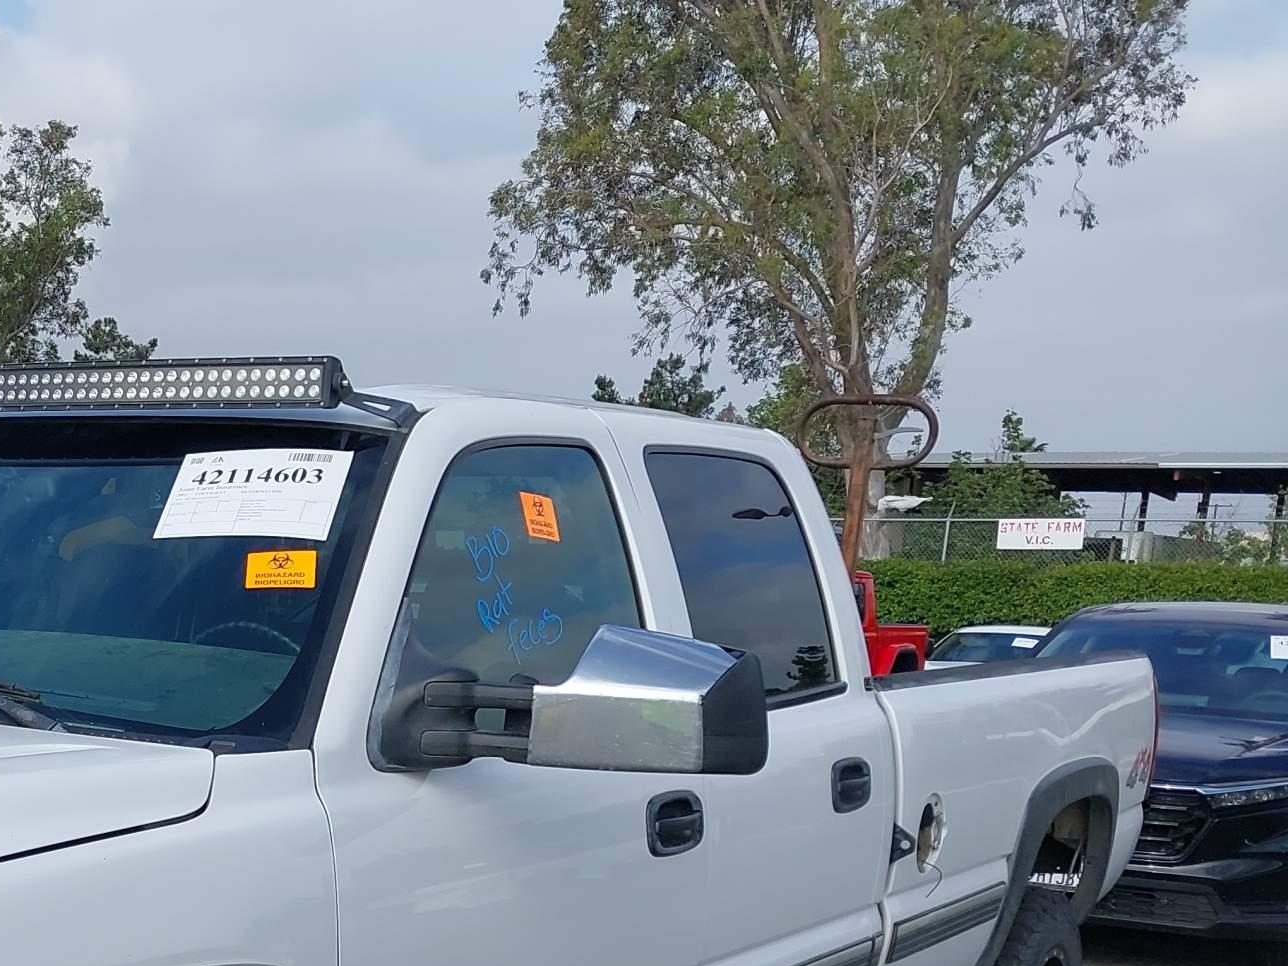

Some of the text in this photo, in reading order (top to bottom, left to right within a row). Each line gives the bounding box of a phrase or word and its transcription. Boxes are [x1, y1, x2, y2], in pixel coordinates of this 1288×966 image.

[192, 467, 324, 485] 42114603
[1001, 522, 1082, 533] STATE FARM
[1025, 536, 1054, 544] V.I.C.
